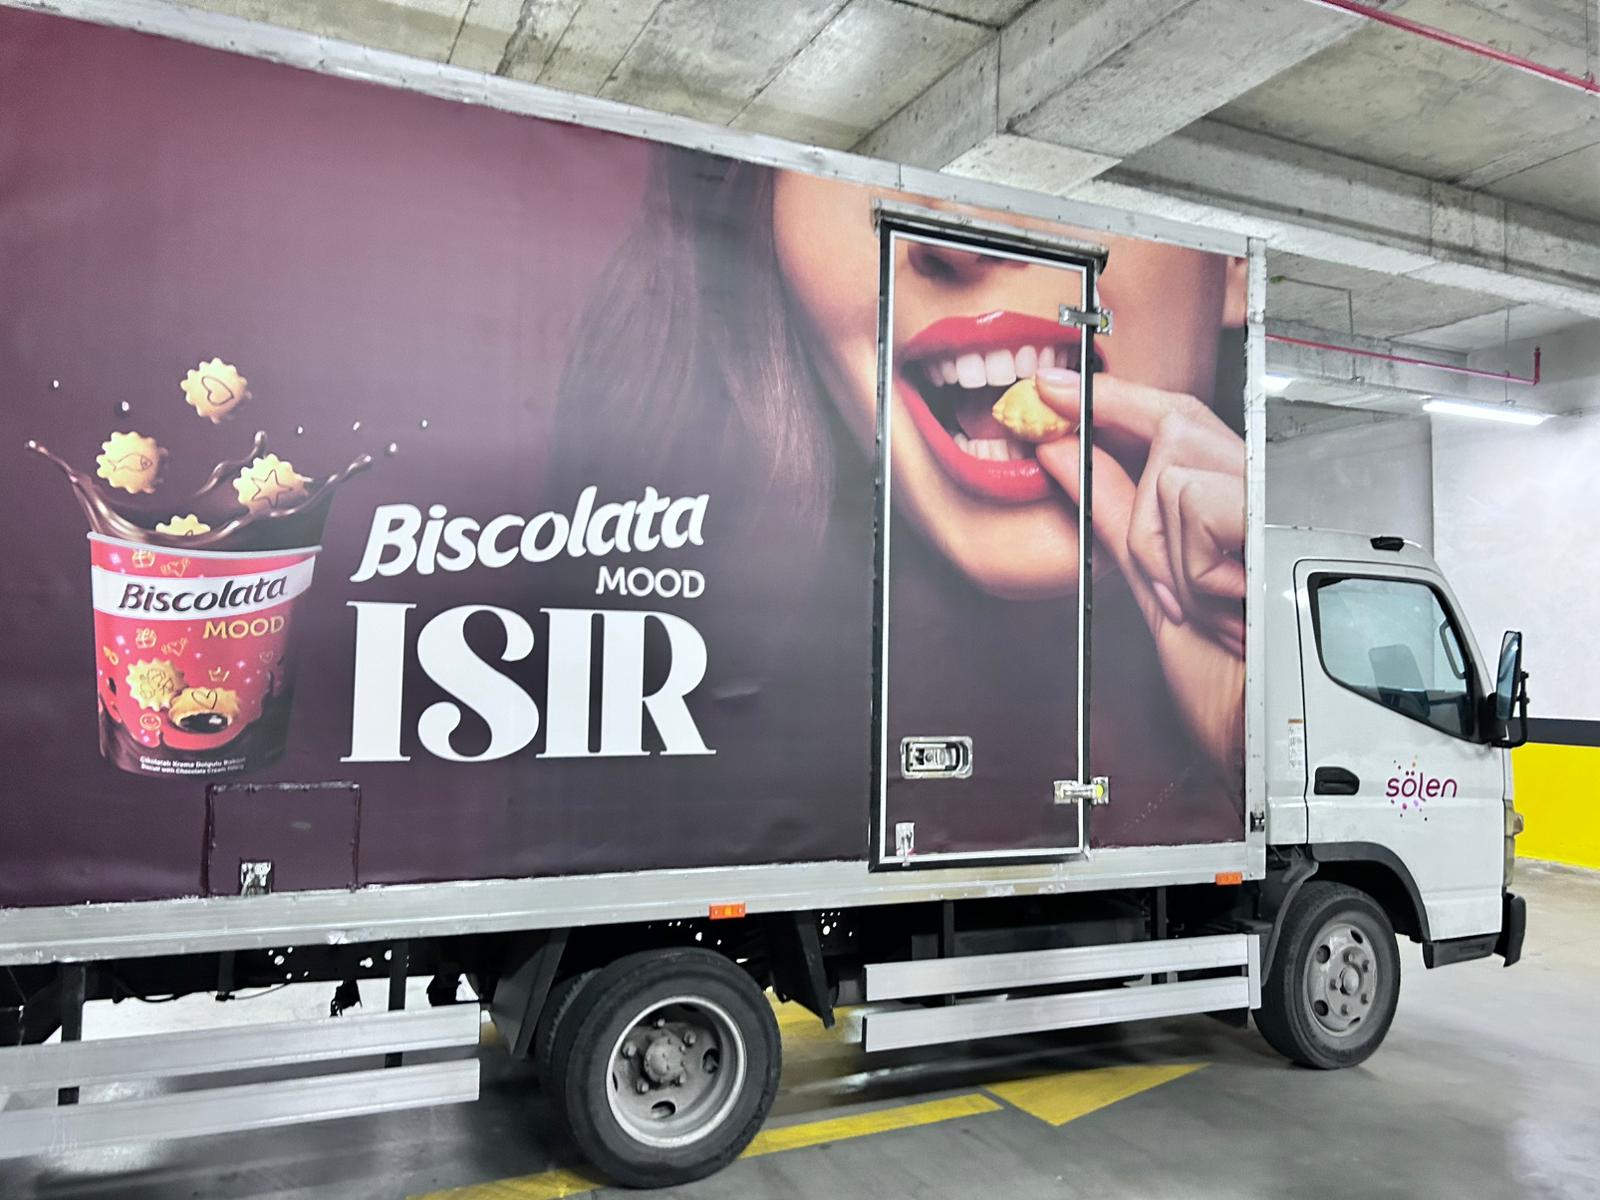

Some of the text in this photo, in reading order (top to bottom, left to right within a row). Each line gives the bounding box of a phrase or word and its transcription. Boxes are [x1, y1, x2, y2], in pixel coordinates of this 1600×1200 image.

[349, 485, 710, 583] Biscolata
[118, 574, 288, 612] Biscolata
[594, 565, 706, 598] MOOD
[202, 615, 285, 640] MOOD
[339, 600, 717, 763] ISIR
